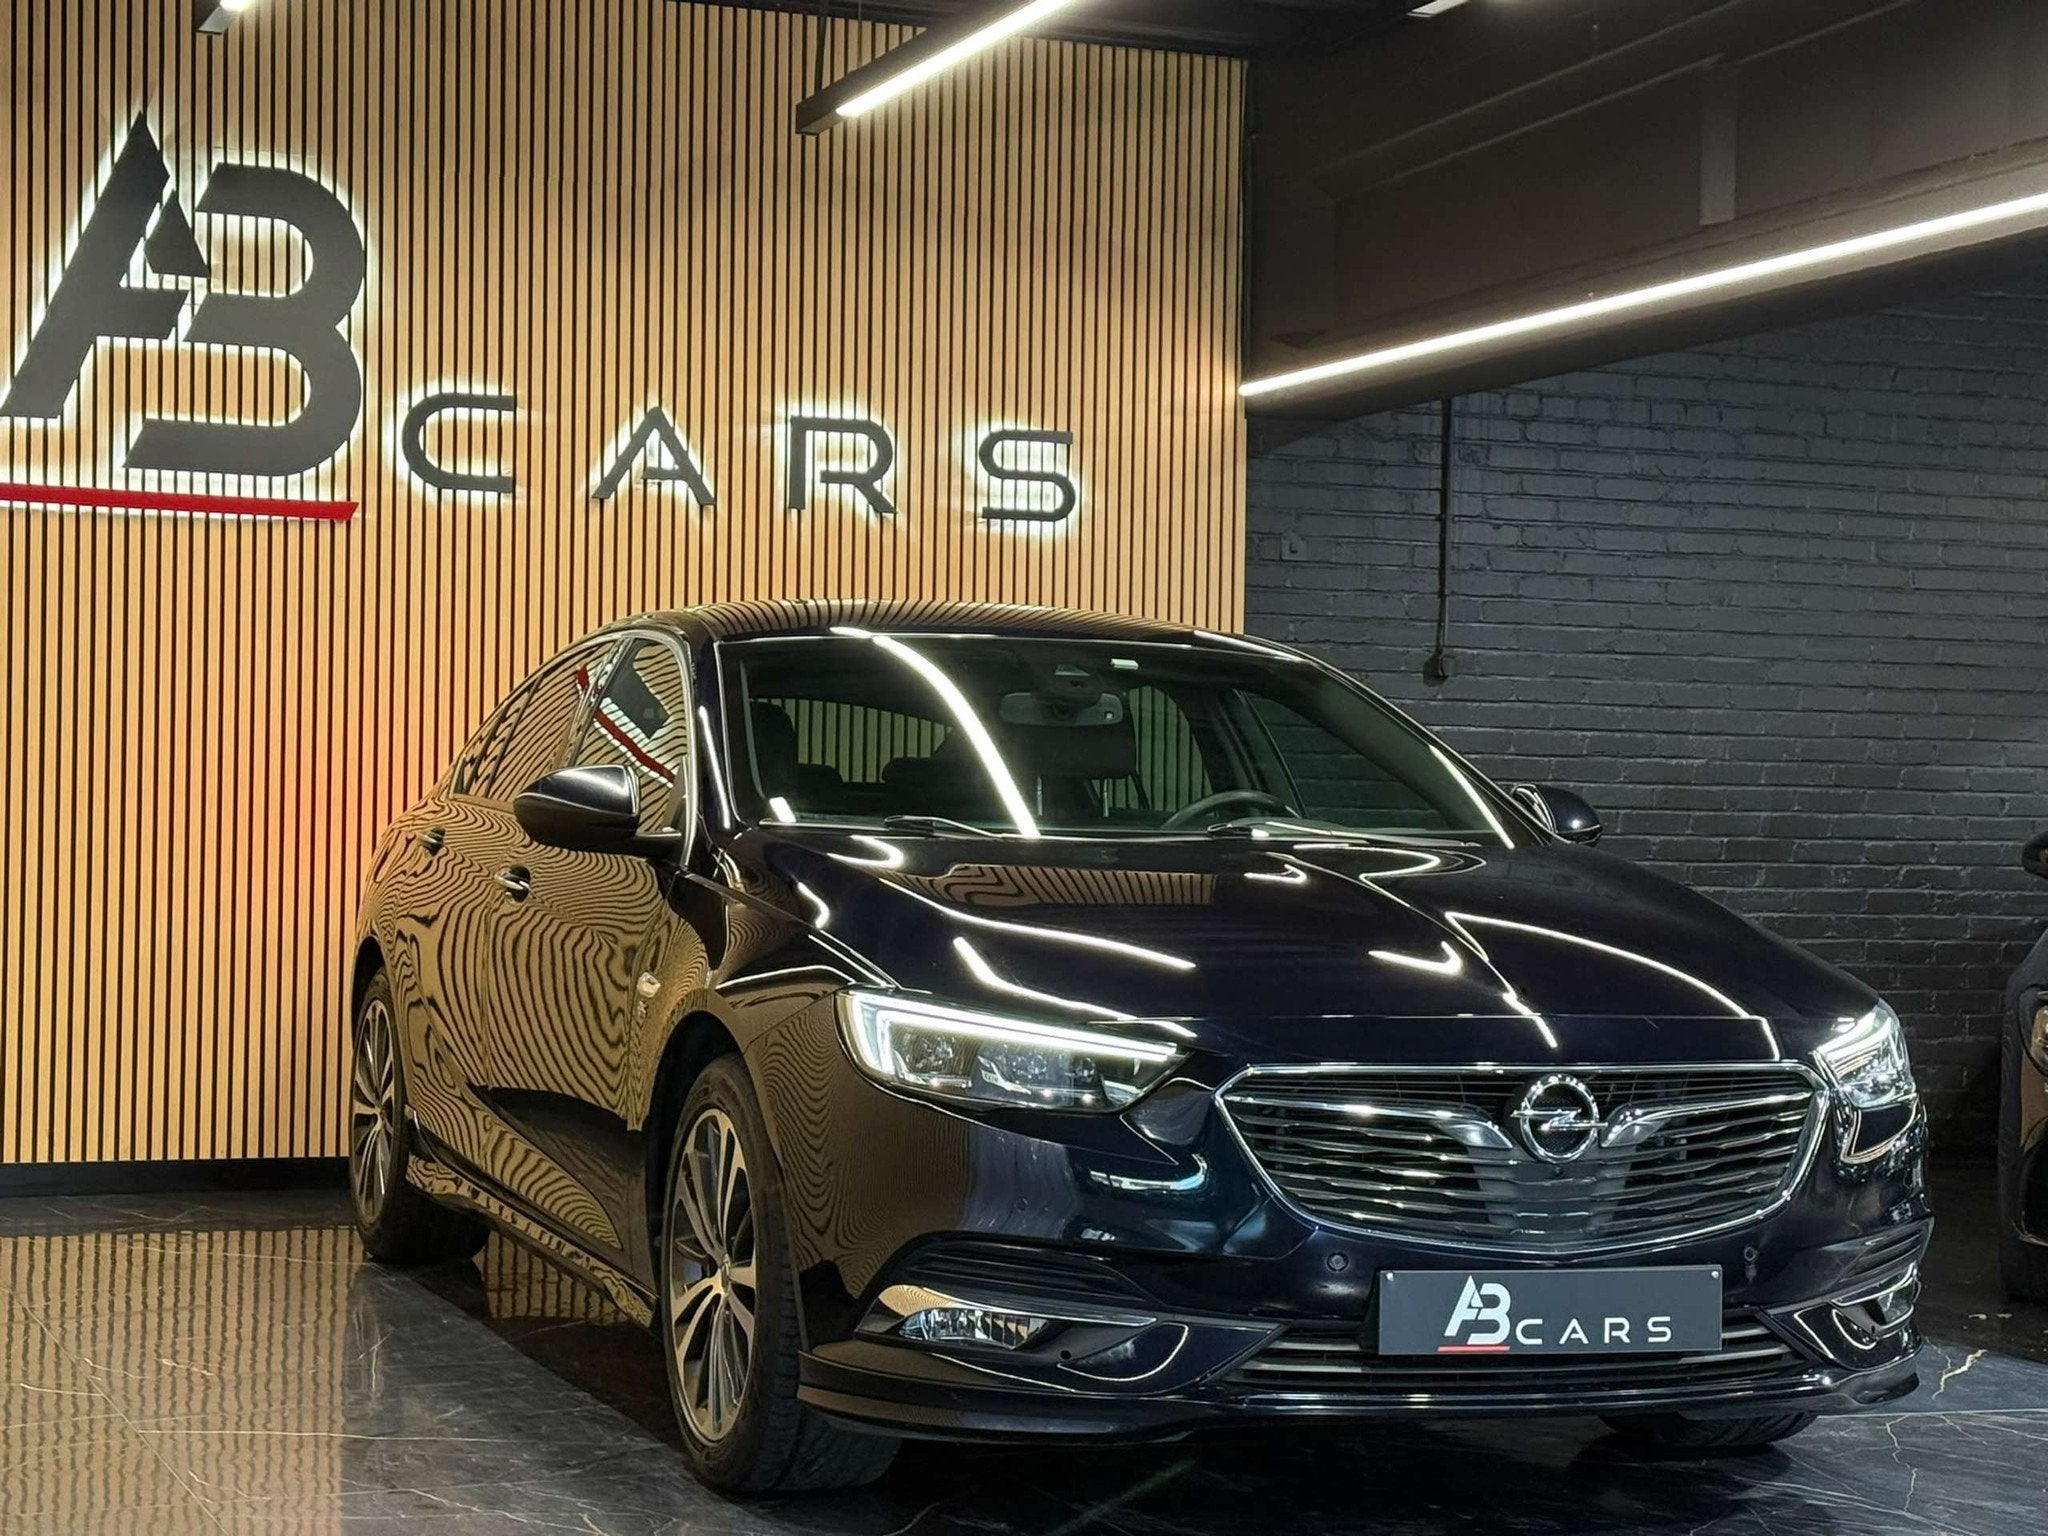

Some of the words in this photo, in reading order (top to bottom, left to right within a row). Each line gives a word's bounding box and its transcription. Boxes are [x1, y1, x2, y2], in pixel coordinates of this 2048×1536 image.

[0, 110, 364, 476] AB
[402, 392, 1076, 522] CARS
[1444, 1275, 1511, 1345] AB
[1515, 1316, 1672, 1345] CARS
